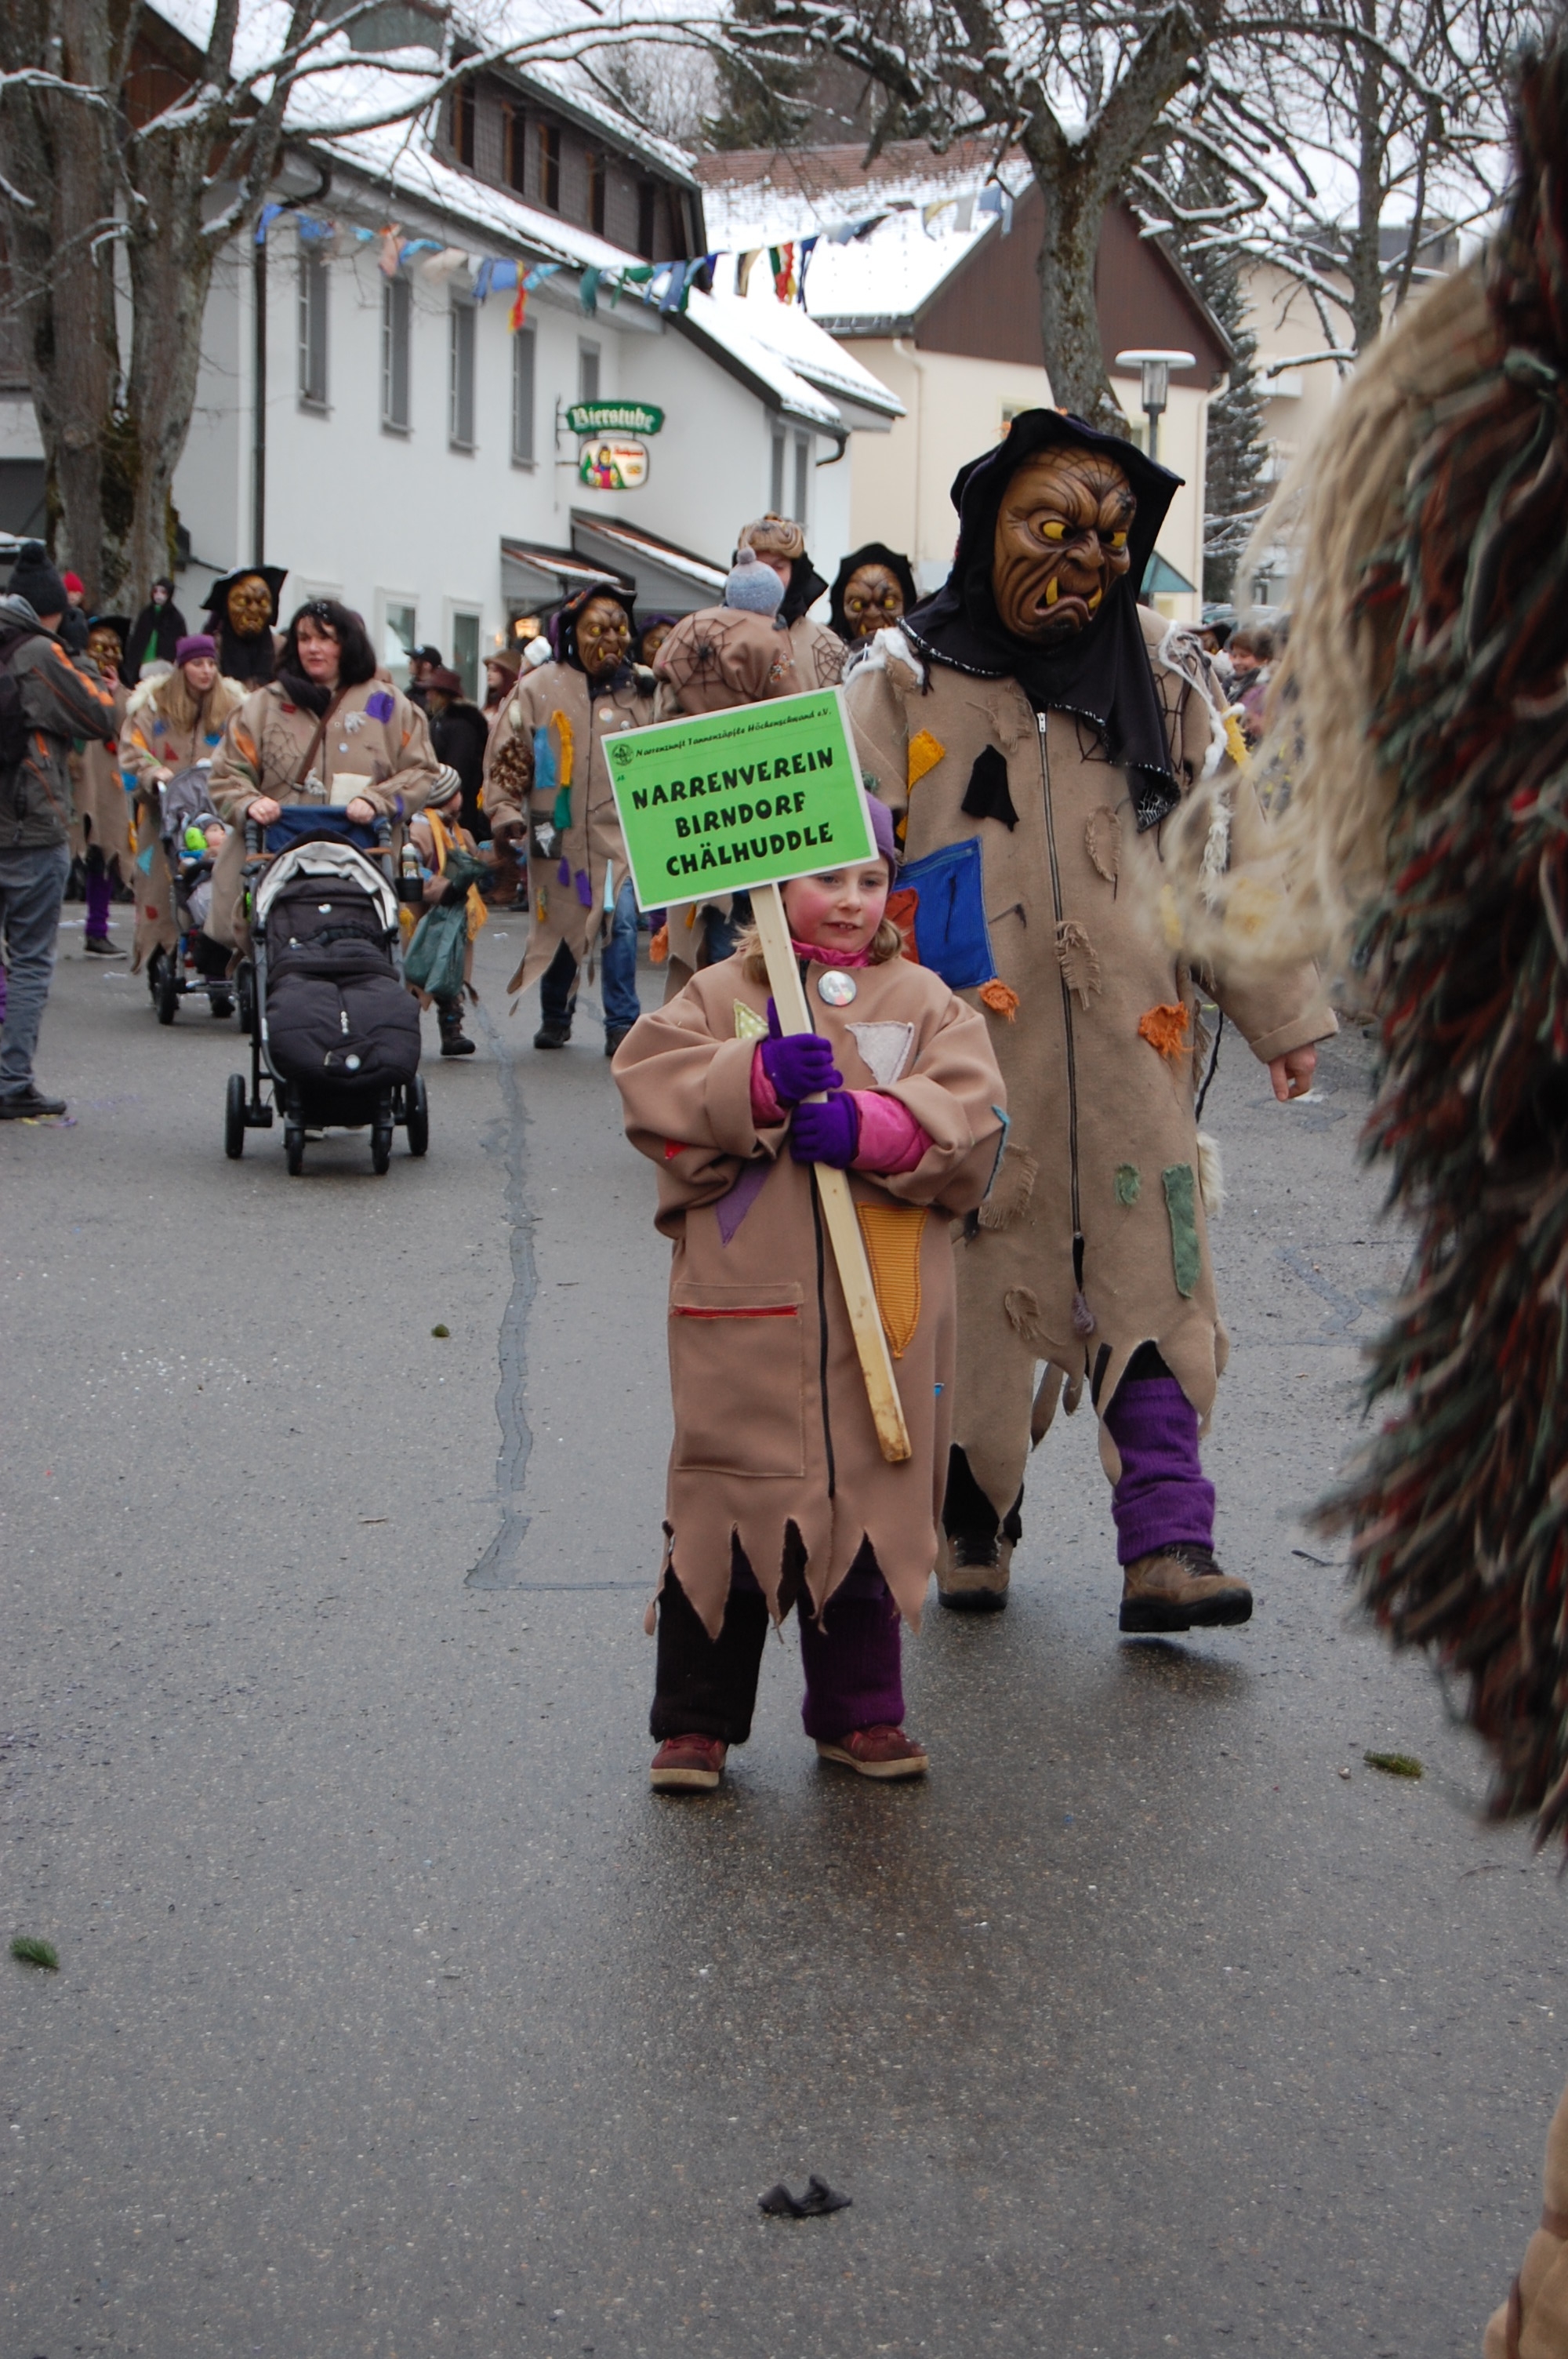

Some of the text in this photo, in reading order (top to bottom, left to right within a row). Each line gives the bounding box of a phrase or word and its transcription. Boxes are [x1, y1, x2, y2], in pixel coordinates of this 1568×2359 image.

[572, 406, 655, 433] Bierstube
[632, 747, 834, 810] NARRENVEREIN
[675, 791, 807, 838] BIRNDORF
[666, 822, 834, 877] CHÄLHUDDLE
